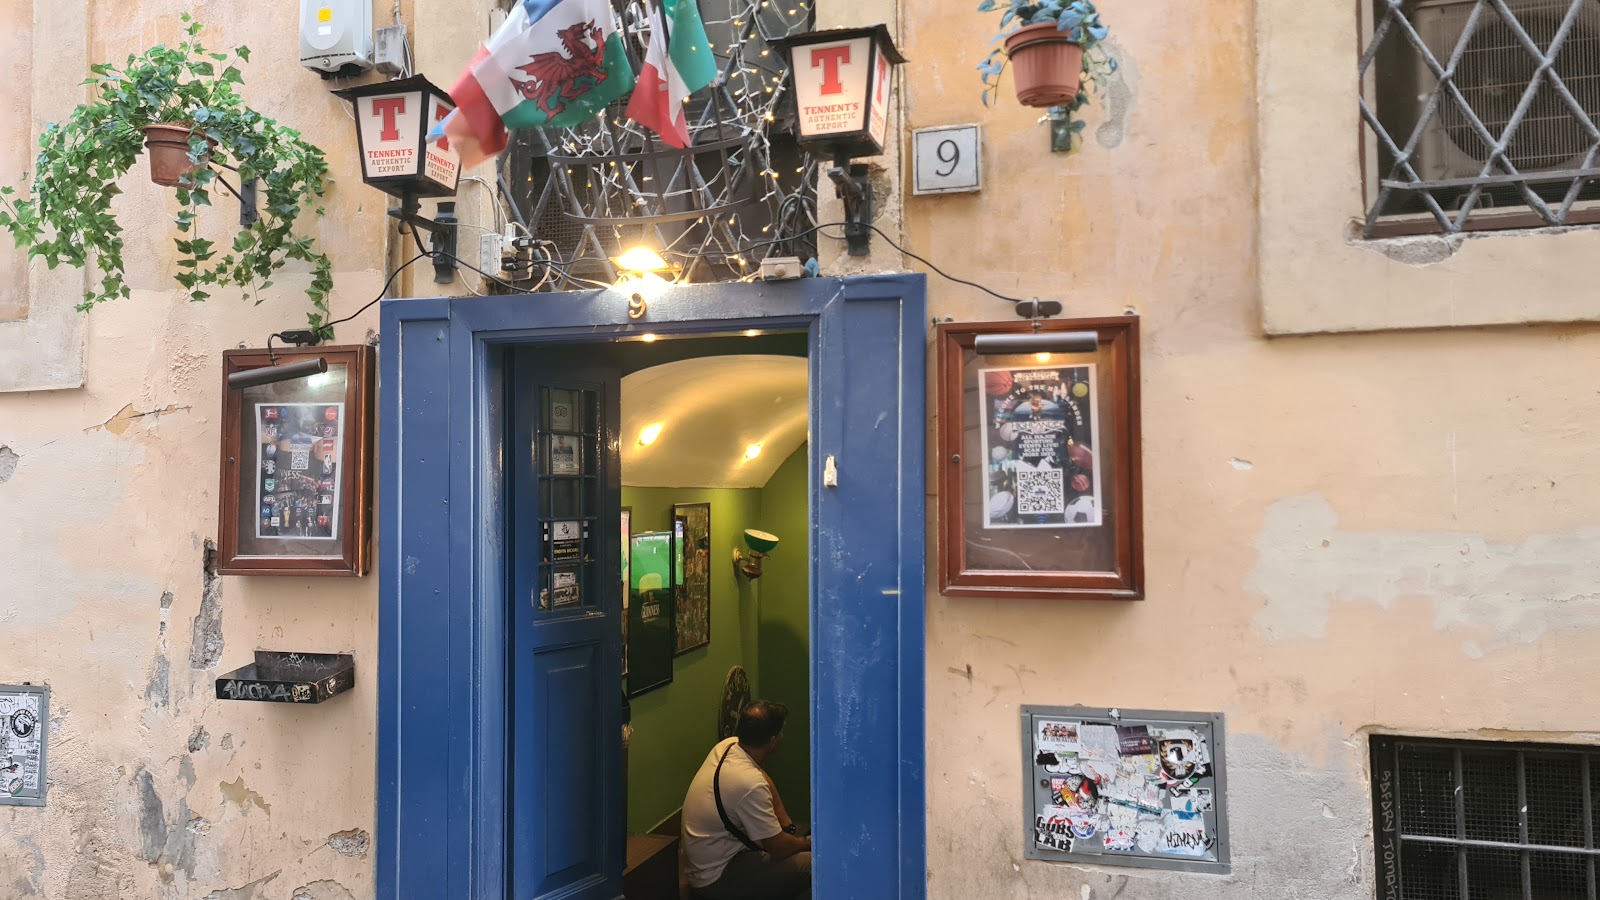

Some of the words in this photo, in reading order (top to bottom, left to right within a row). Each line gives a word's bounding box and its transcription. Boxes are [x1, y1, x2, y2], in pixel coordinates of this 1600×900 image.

[811, 45, 849, 95] T
[804, 102, 859, 115] TENNENT'S
[372, 97, 405, 141] T
[808, 112, 856, 123] AUTHENTIC
[816, 121, 848, 130] EXPORT
[367, 148, 413, 158] TENNENT'S
[935, 139, 960, 177] 9
[371, 157, 411, 165] AUTHENTIC
[426, 151, 456, 171] TENNENT'S
[378, 165, 405, 173] EXPORT
[427, 161, 453, 177] AUTHENTIC
[430, 169, 448, 182] EXPORT
[628, 292, 647, 319] 9
[1015, 387, 1026, 395] TO
[641, 603, 660, 619] GUINNESS
[1035, 832, 1072, 852] LAB
